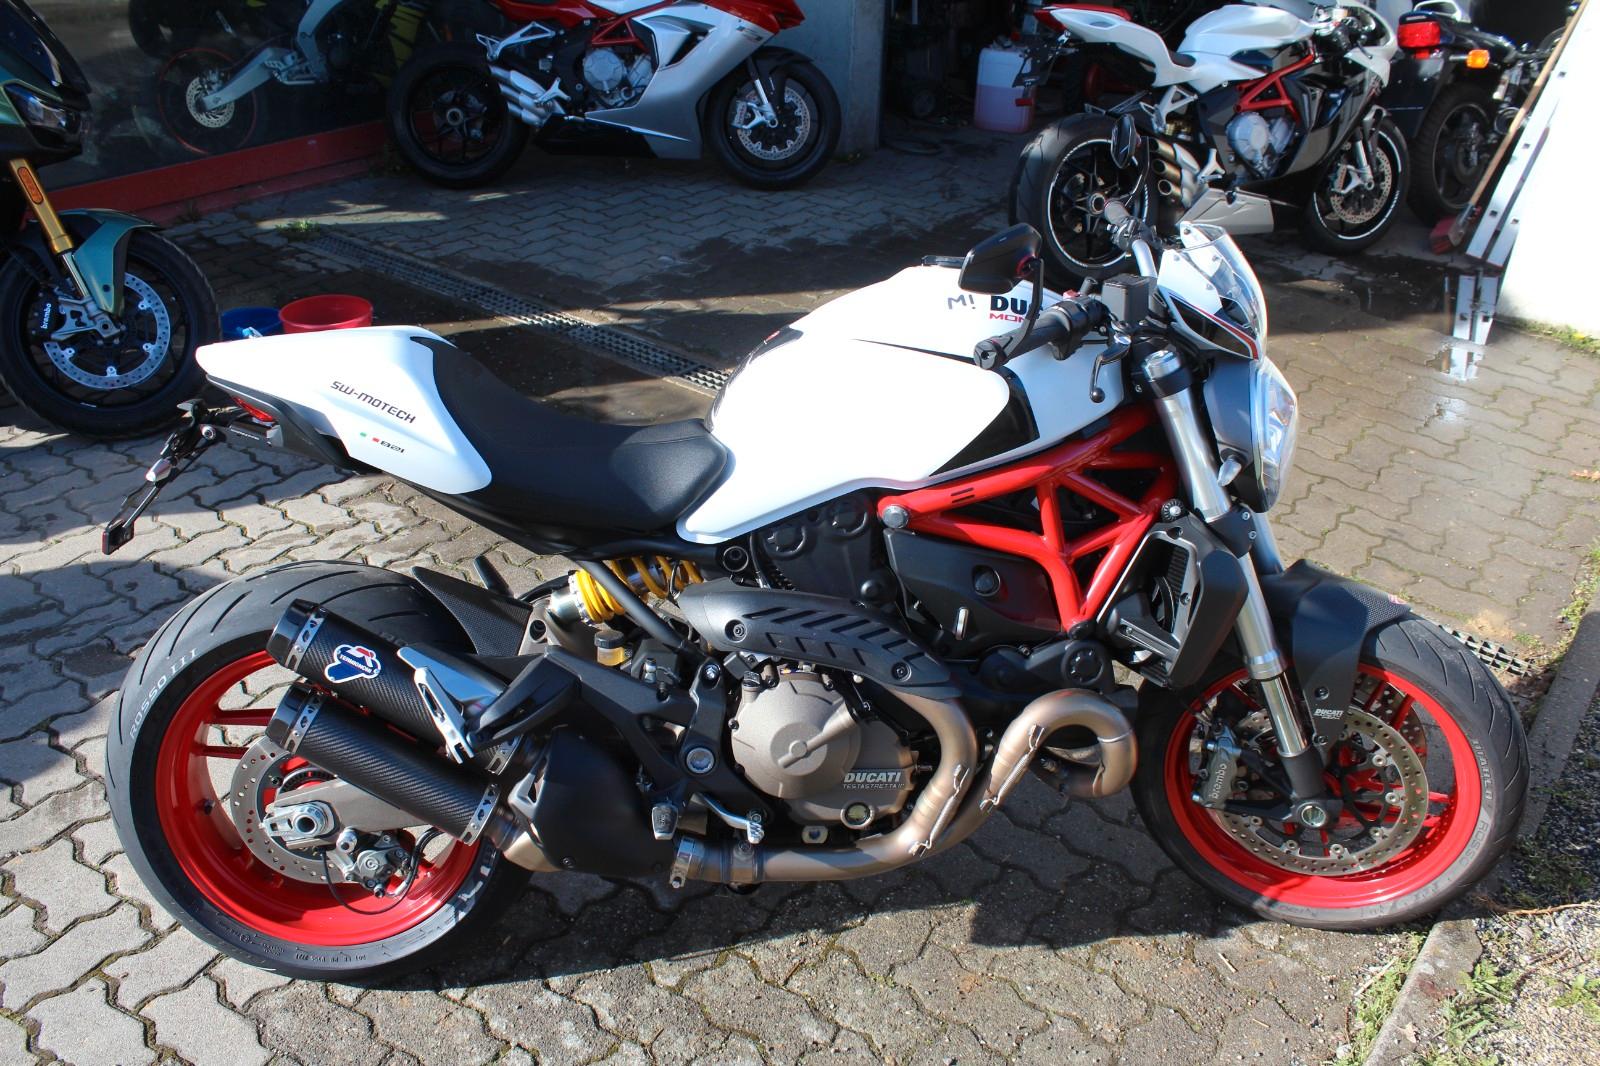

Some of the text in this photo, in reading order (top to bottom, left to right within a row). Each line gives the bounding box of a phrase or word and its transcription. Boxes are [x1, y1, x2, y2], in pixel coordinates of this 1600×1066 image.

[40, 303, 52, 329] brembo
[330, 380, 416, 424] SW-MOTECH
[129, 675, 167, 740] ROSSO
[844, 771, 902, 783] DUCATI
[1208, 763, 1228, 799] brembo
